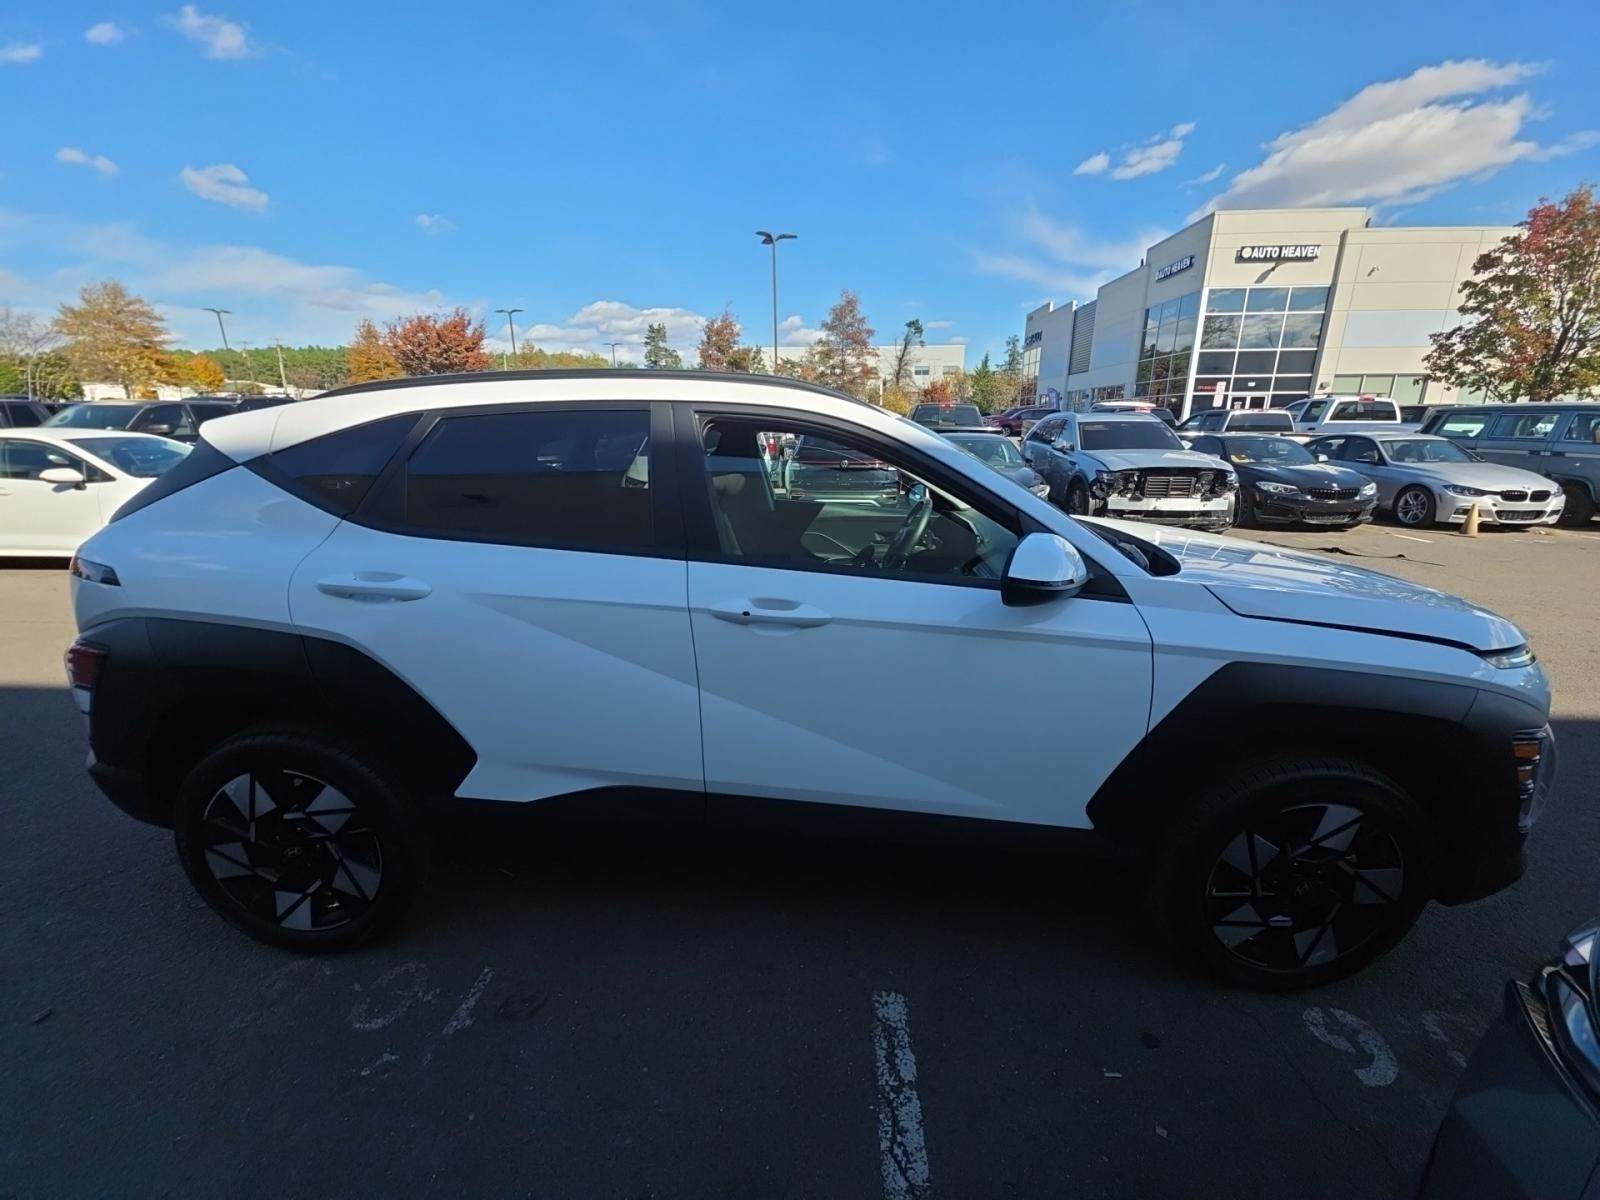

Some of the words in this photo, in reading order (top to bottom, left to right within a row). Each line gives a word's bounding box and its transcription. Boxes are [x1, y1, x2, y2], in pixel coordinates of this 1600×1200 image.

[1251, 246, 1280, 258] AUTO
[1281, 245, 1321, 257] HEAVEN
[1158, 265, 1171, 278] AUTO
[1171, 257, 1190, 273] HEAVEN
